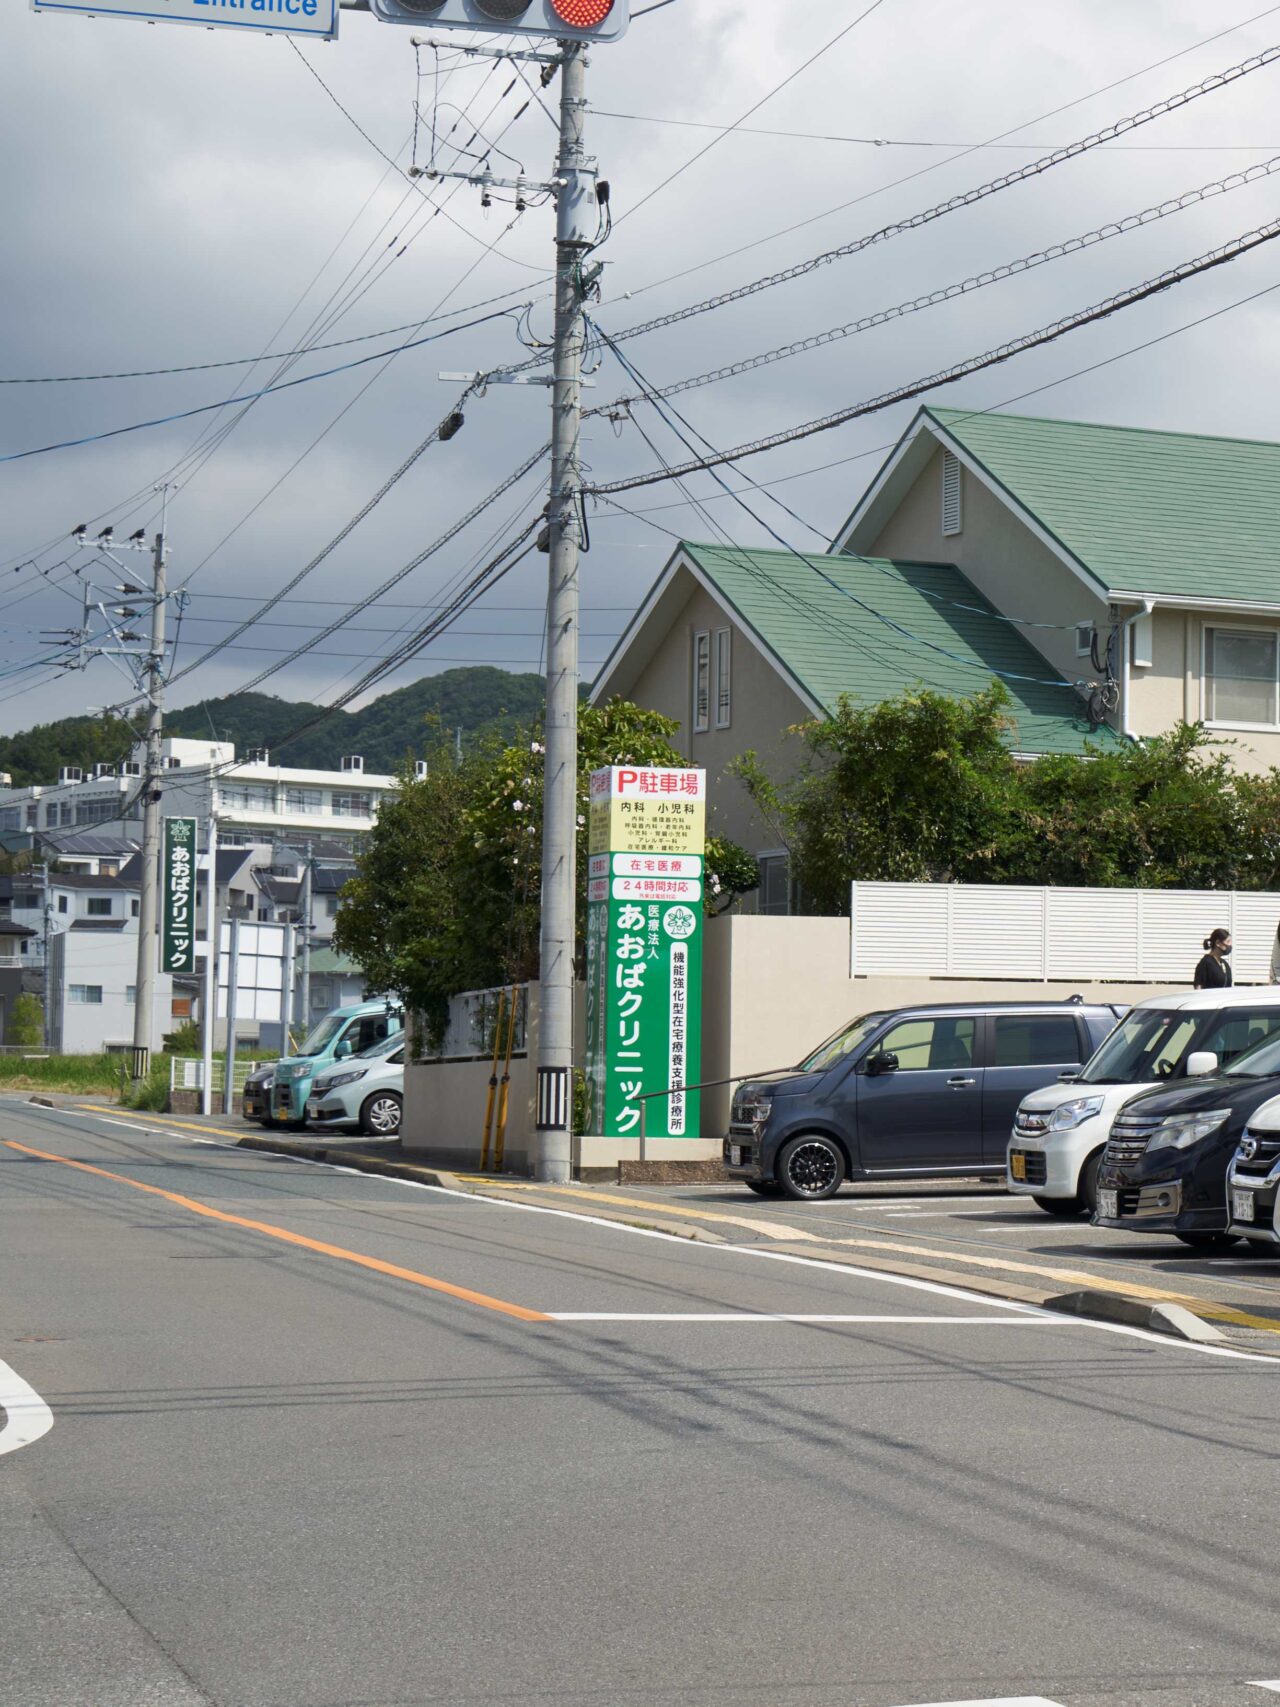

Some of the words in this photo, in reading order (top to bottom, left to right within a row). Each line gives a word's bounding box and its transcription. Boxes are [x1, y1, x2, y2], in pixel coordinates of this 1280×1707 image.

[193, 0, 318, 16] rance
[618, 771, 699, 795] P駐車場
[621, 802, 645, 813] 内科
[657, 803, 694, 814] 小児科
[630, 859, 682, 872] 在宅医療
[623, 880, 689, 893] 24時間対応
[170, 846, 191, 968] あおばクリニック
[647, 905, 660, 960] 医療法人
[614, 904, 647, 1133] あおばクリニック
